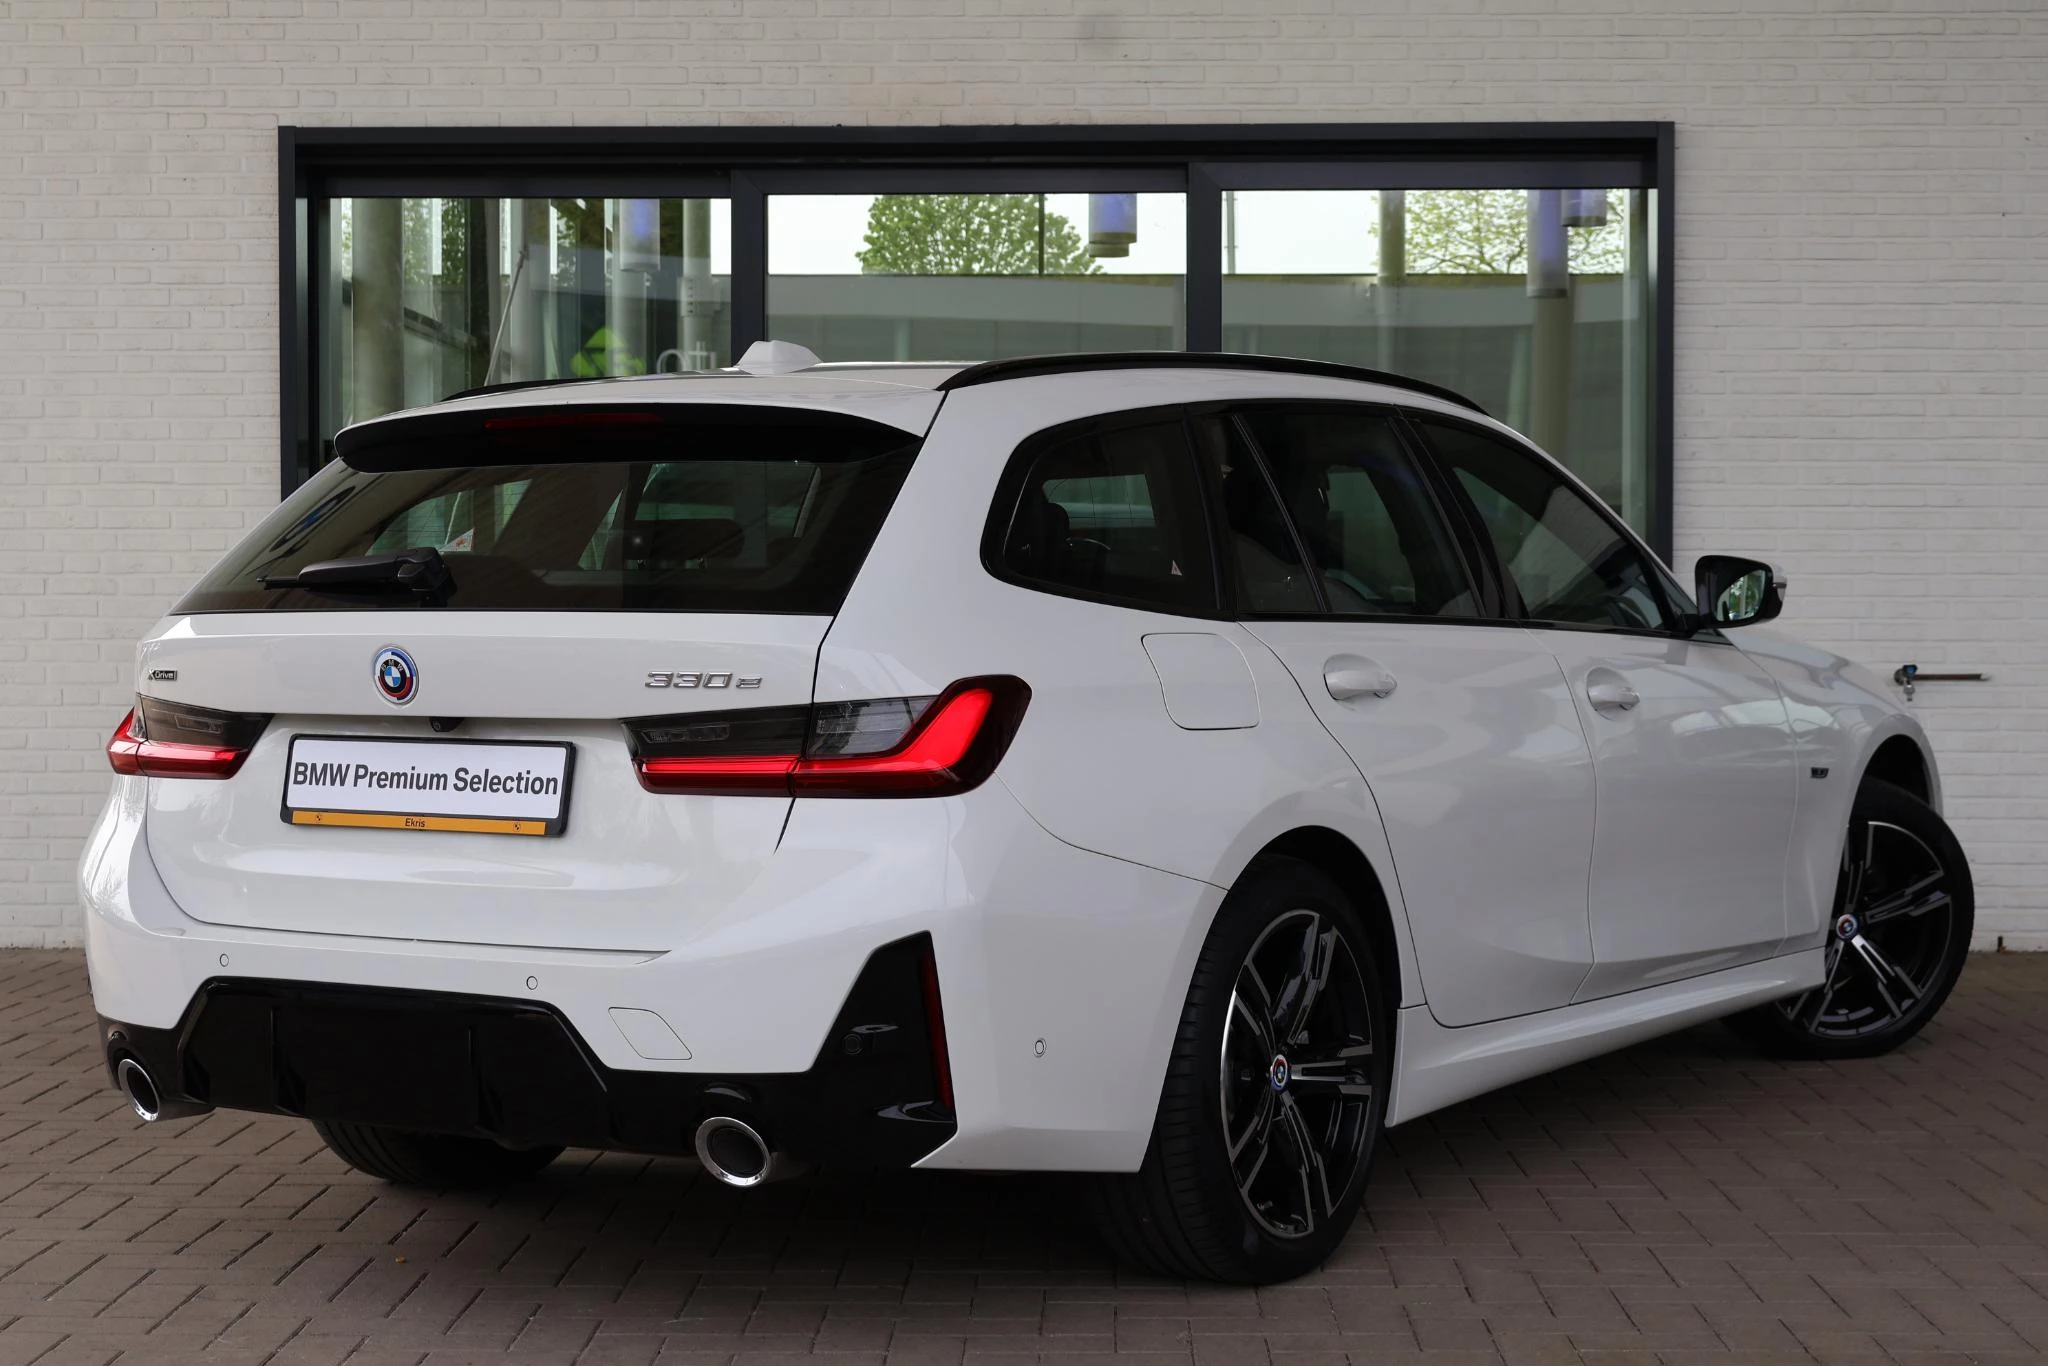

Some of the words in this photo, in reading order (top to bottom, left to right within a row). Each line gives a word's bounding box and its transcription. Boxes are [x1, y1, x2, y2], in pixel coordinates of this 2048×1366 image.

[293, 762, 350, 787] BMW
[353, 764, 448, 791] Premium
[453, 767, 558, 795] Selection
[405, 817, 426, 828] Ekris
